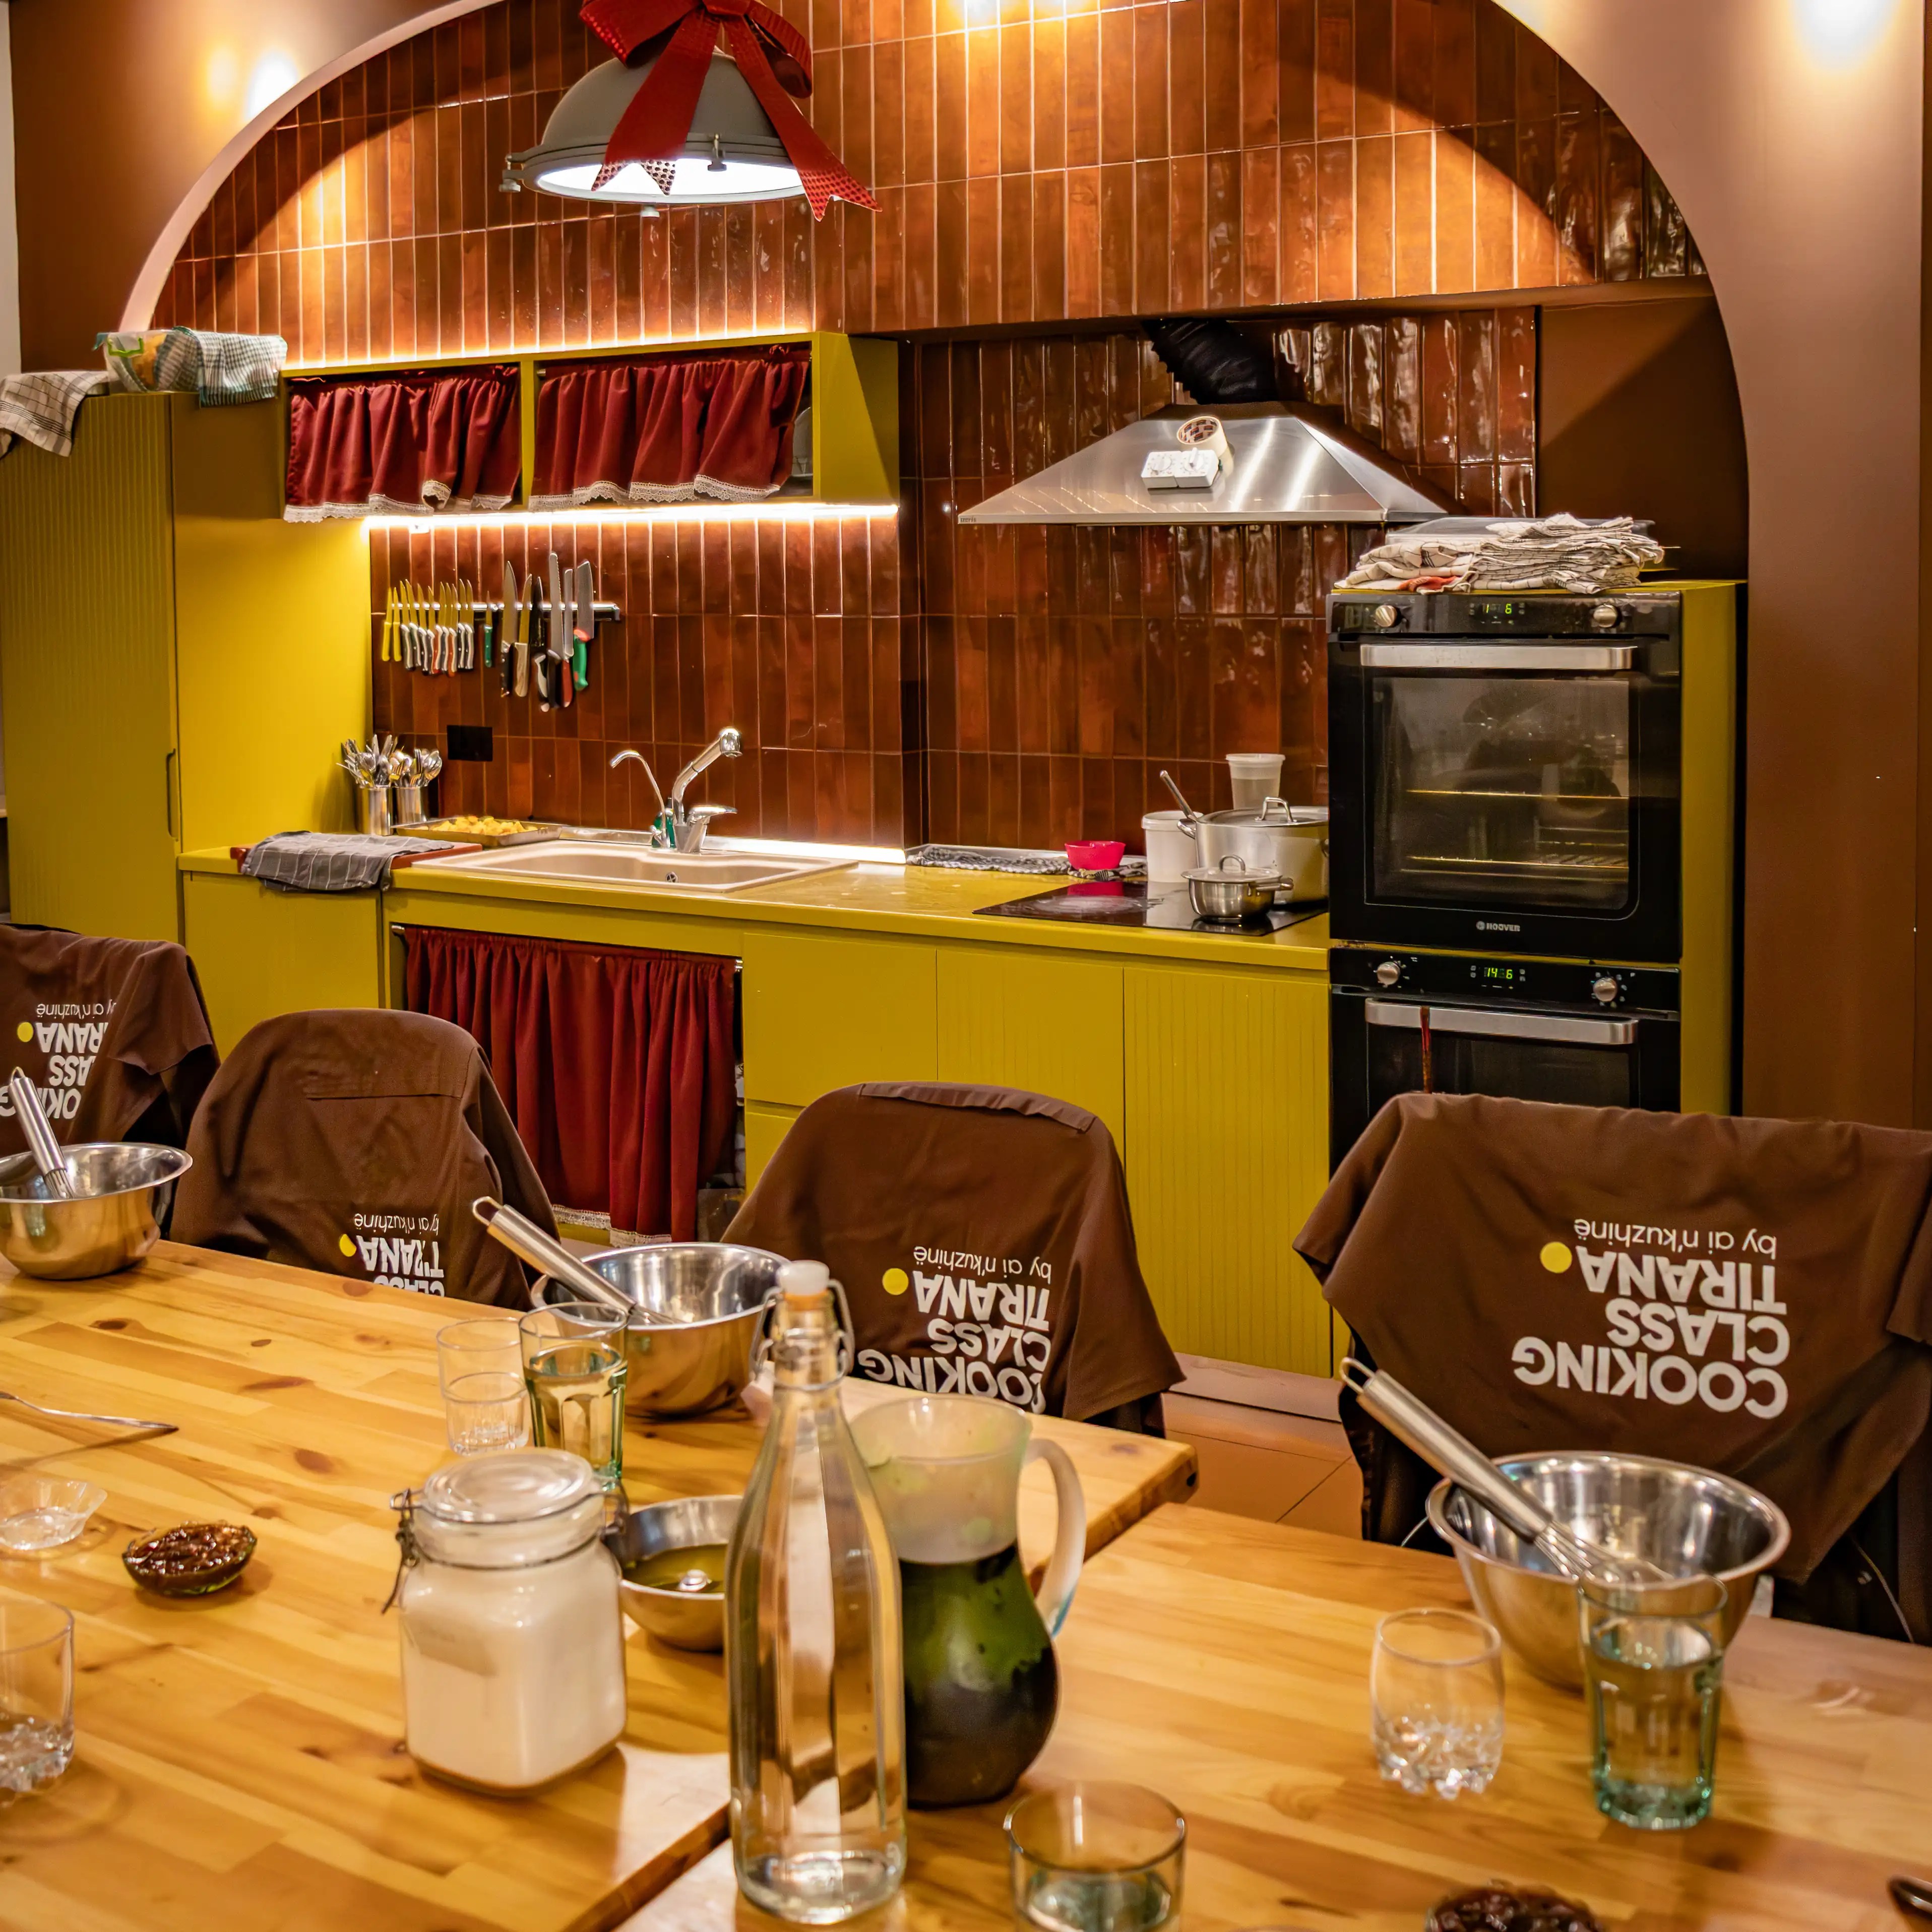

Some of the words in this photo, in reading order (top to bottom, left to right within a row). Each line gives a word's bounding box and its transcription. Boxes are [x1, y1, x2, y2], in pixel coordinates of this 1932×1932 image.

[1486, 922, 1520, 931] HOOVER
[35, 1022, 109, 1053] RANA
[49, 1055, 97, 1086] ASS
[418, 1217, 429, 1234] ai
[1574, 1218, 1699, 1253] n'kuzhinë
[1708, 1230, 1734, 1254] ai
[1742, 1228, 1777, 1260] by
[913, 1246, 996, 1276] n'kuzhinë
[1002, 1258, 1022, 1278] ai
[1029, 1256, 1052, 1284] by
[1575, 1245, 1787, 1315] TIRANA
[912, 1270, 1050, 1331] TIRANA
[927, 1318, 1051, 1372] CLASS
[1605, 1297, 1790, 1366] CLASS
[1512, 1336, 1789, 1420] COOKING
